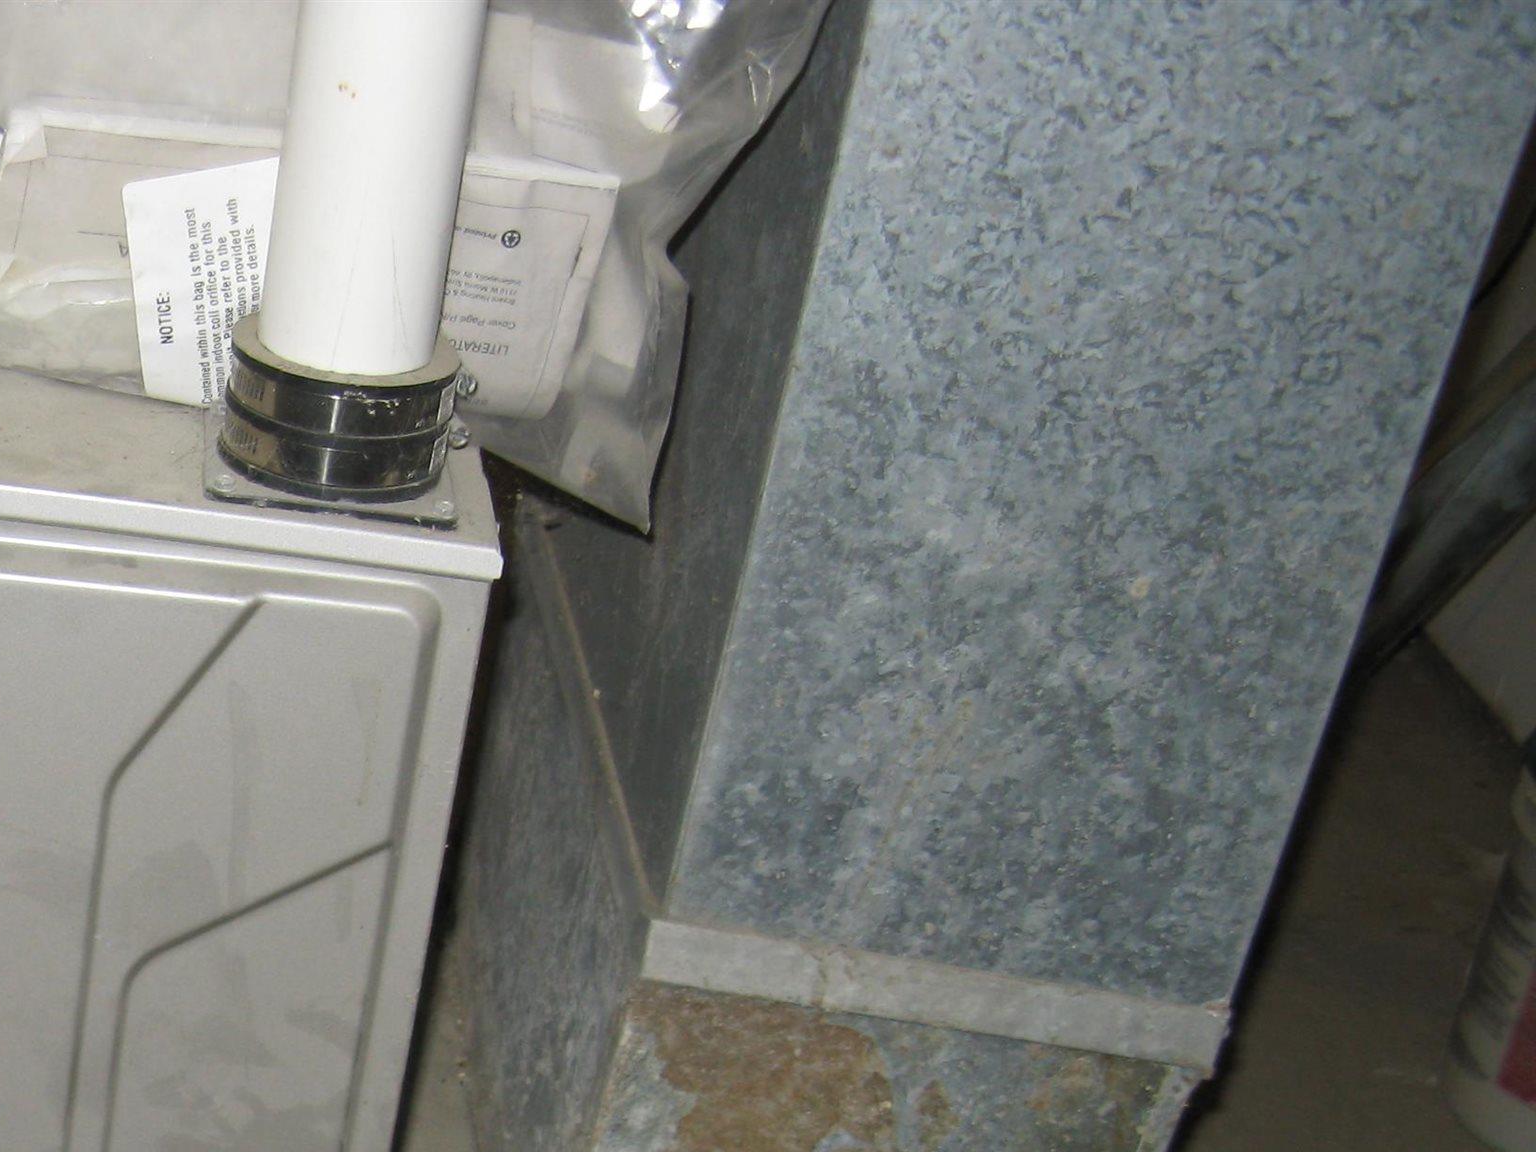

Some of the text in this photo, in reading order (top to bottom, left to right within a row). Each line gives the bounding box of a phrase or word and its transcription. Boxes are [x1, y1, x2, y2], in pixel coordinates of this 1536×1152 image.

[227, 198, 238, 226] with
[218, 236, 228, 258] the
[230, 229, 246, 283] provided
[246, 224, 259, 270] details.
[219, 259, 229, 273] to
[221, 275, 232, 302] refer
[249, 274, 261, 300] more
[156, 292, 174, 345] NOTICE:
[185, 207, 212, 404] Contained within this bag is the most
[201, 222, 226, 400] ommon indoor coil orifice for this
[223, 308, 234, 339] Please
